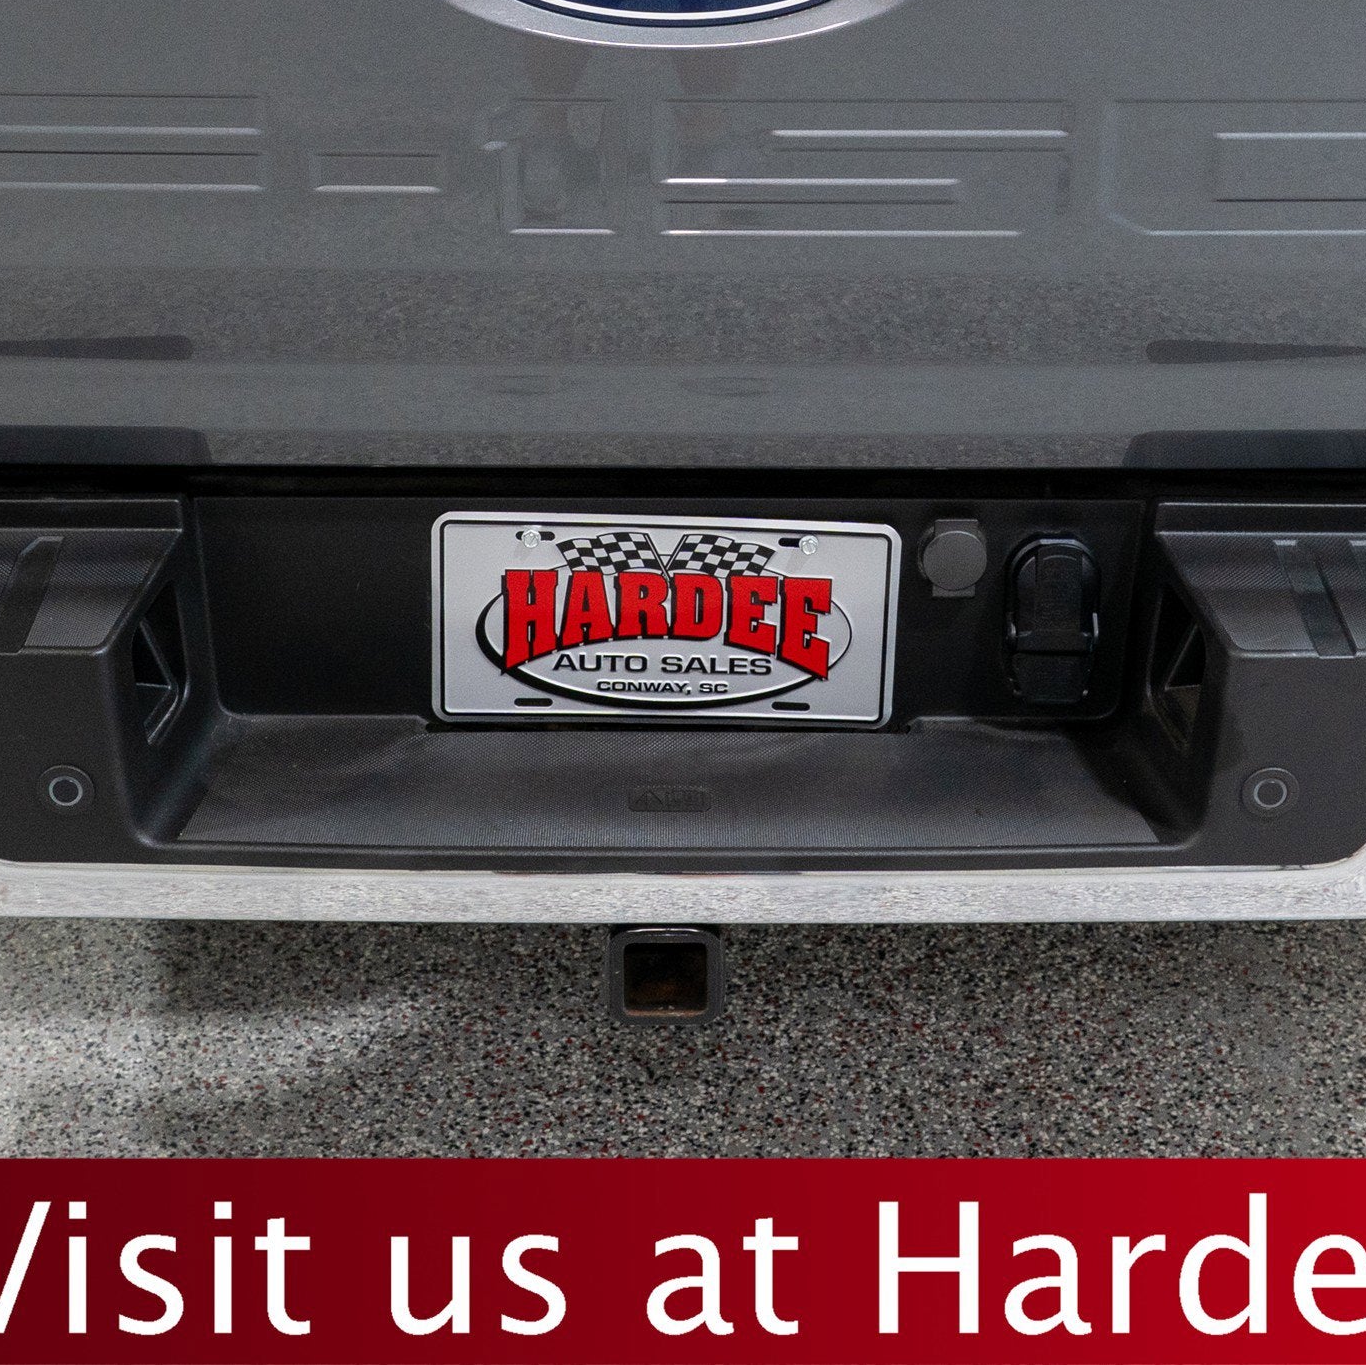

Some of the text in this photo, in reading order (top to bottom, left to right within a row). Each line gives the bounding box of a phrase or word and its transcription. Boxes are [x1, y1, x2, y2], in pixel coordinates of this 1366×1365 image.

[501, 568, 834, 681] HARDEE
[552, 653, 773, 676] AUTO SALES
[596, 680, 729, 696] CONWAY, SC
